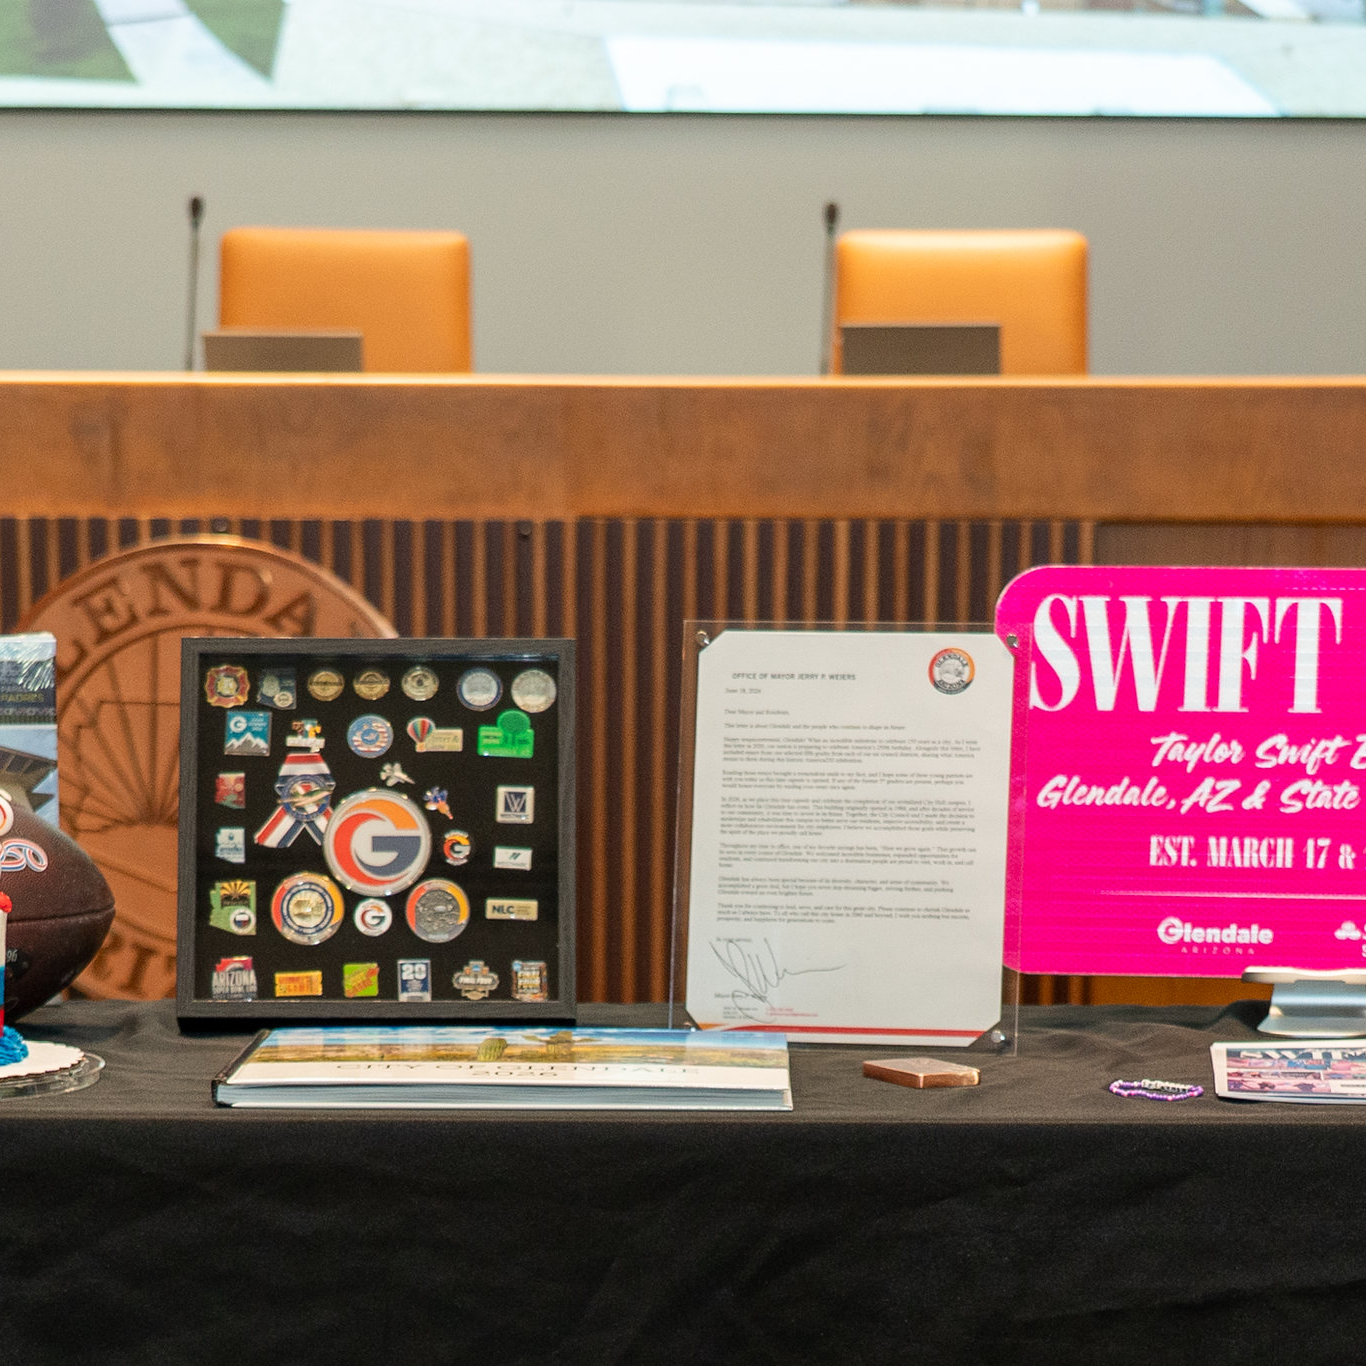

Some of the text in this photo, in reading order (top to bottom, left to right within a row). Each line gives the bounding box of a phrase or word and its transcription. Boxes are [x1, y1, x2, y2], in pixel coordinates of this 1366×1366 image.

[1029, 593, 1343, 714] SWIFT
[797, 673, 819, 681] JERRY
[1150, 731, 1245, 773] Taylor
[1255, 733, 1352, 776] Swift
[1036, 774, 1177, 810] Glendale,
[1180, 776, 1242, 815] AZ
[1241, 779, 1272, 810] &
[1279, 778, 1361, 814] State
[1149, 835, 1197, 867] EST.
[1207, 836, 1295, 869] MARCH
[1302, 837, 1331, 870] 17
[1338, 843, 1357, 870] &
[492, 904, 515, 915] NLC
[1157, 916, 1274, 945] Glendale
[1180, 946, 1255, 955] ARIZONA
[212, 969, 257, 987] ARIZONA
[497, 1065, 699, 1074] GLENDALE
